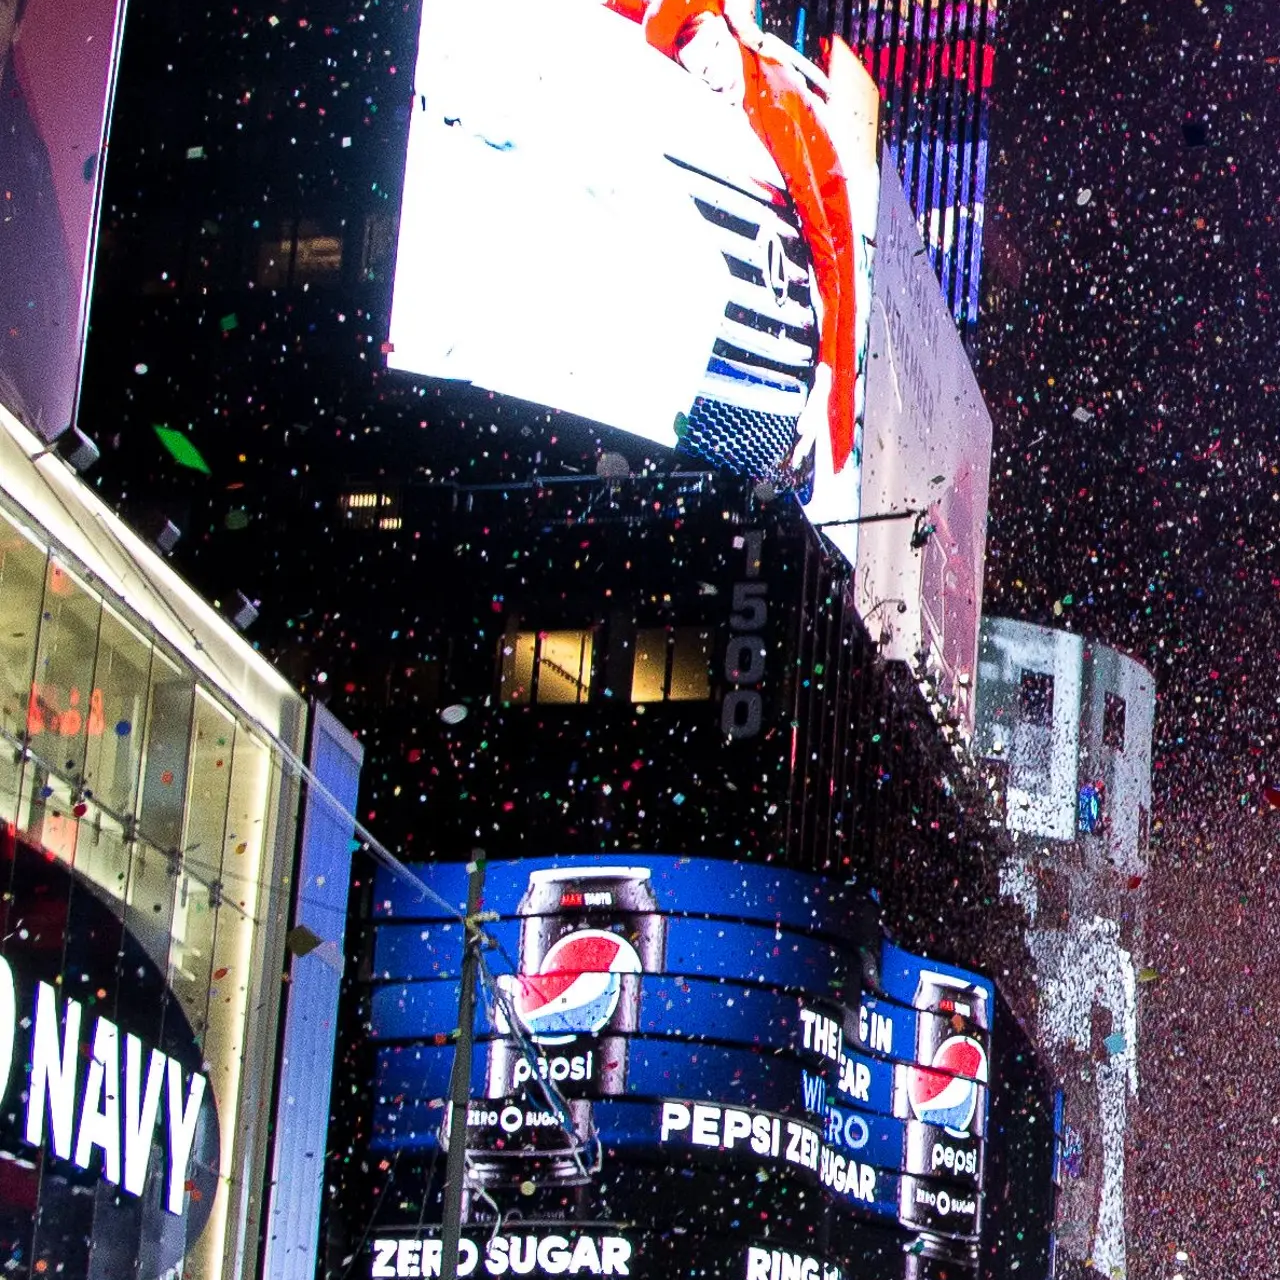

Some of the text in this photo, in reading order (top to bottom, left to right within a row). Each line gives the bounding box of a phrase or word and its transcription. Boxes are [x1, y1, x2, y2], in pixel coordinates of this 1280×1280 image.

[25, 980, 207, 1216] NAVY
[659, 1101, 780, 1158] PEPSI
[931, 1143, 977, 1177] pepsi
[484, 1235, 632, 1276] SUGAR
